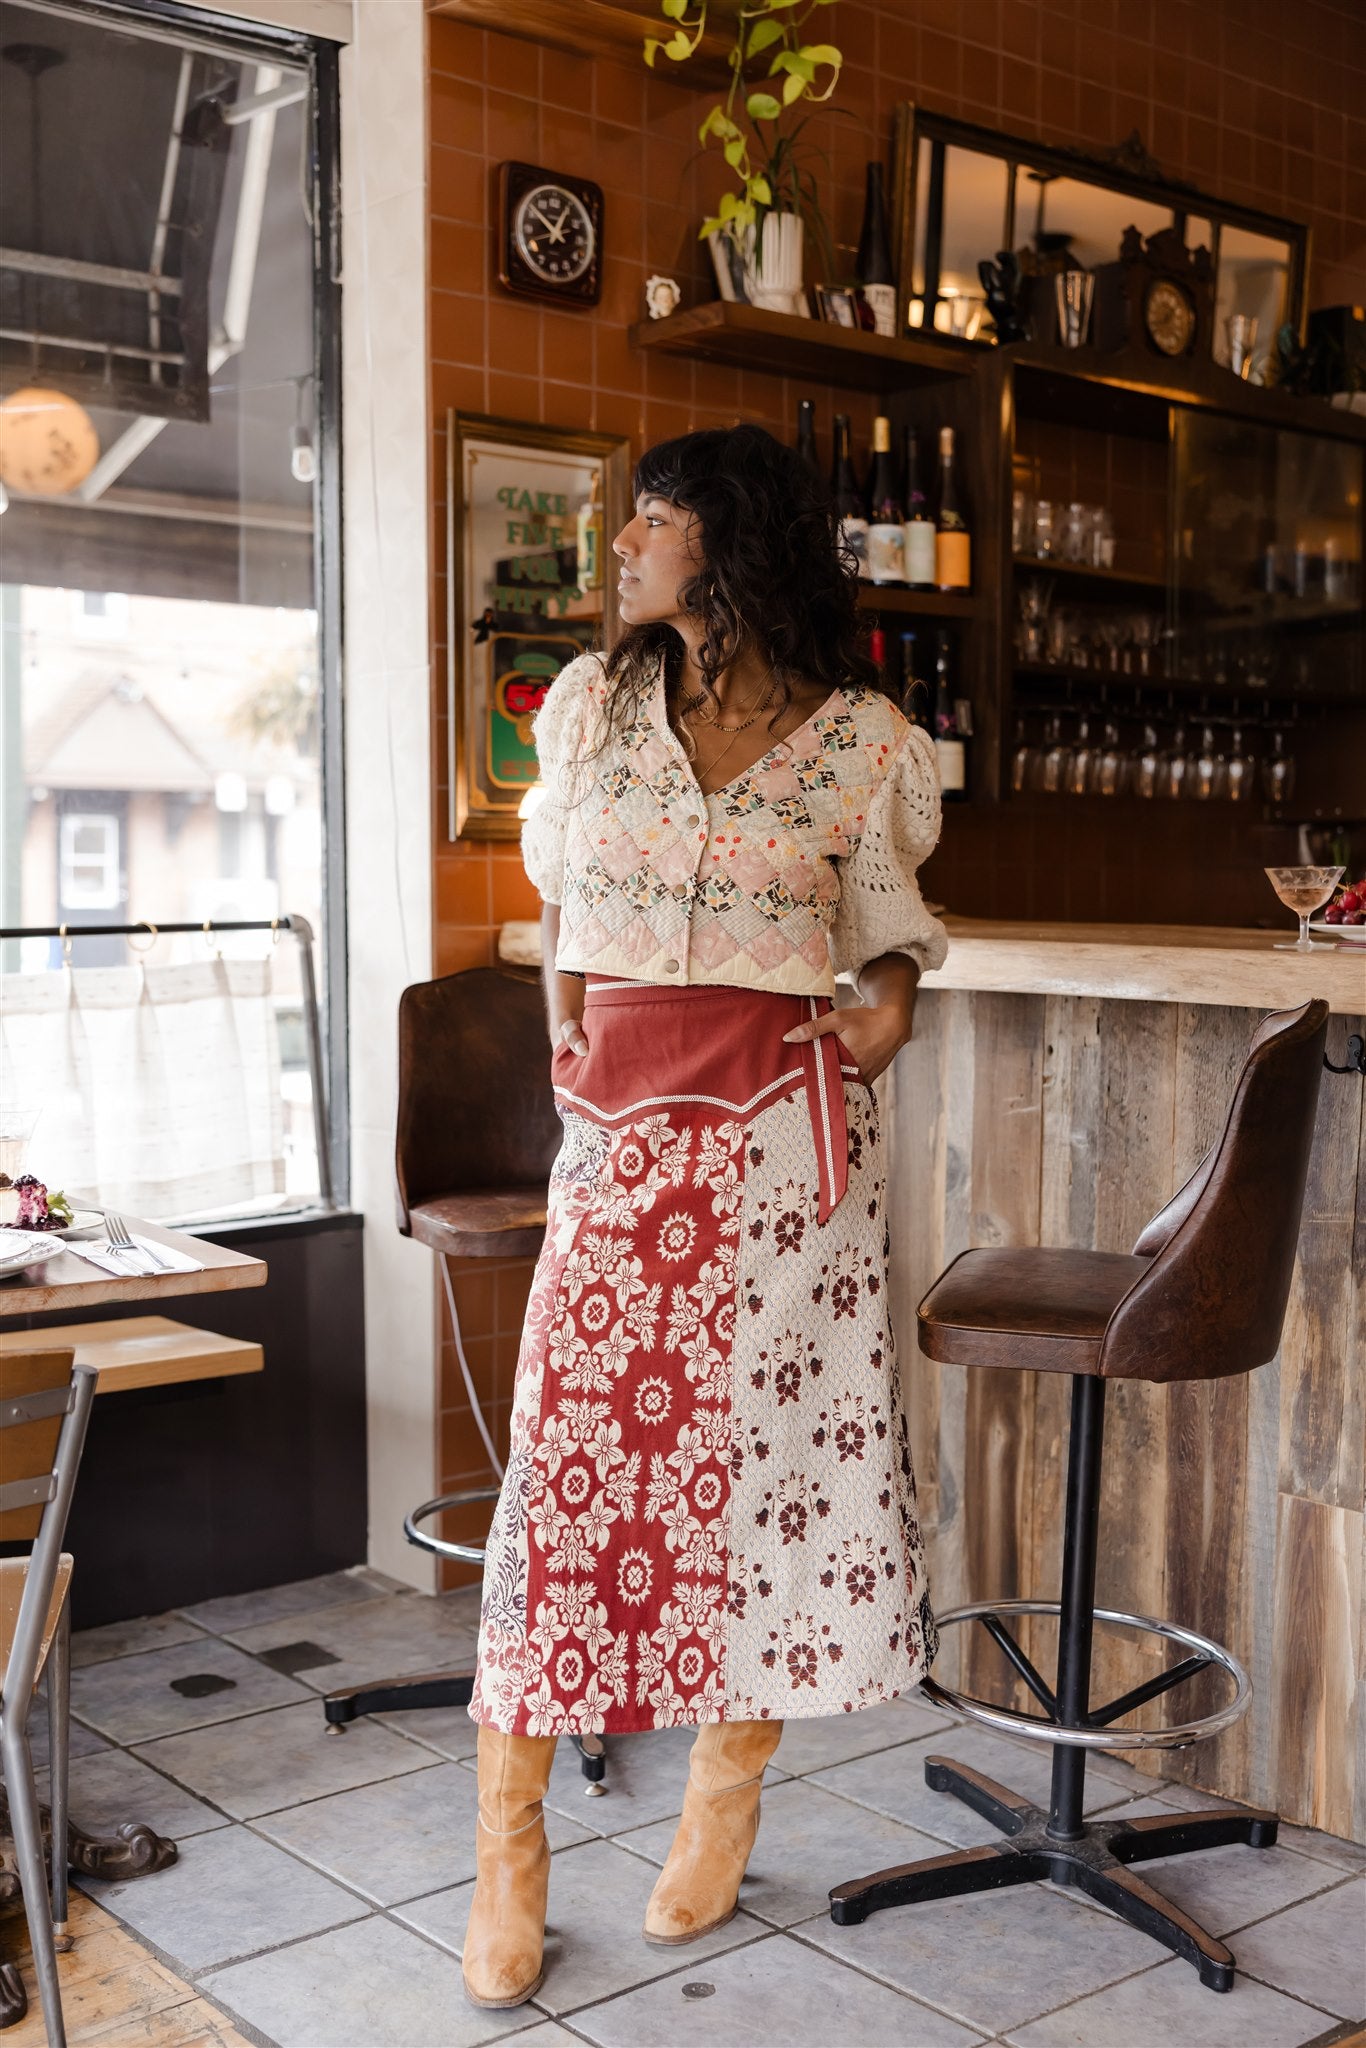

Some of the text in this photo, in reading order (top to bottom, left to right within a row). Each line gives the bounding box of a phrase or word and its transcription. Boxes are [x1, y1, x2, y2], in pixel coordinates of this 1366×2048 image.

[497, 487, 568, 516] TAKE
[507, 521, 564, 551] FIVE
[511, 556, 561, 584] FOR
